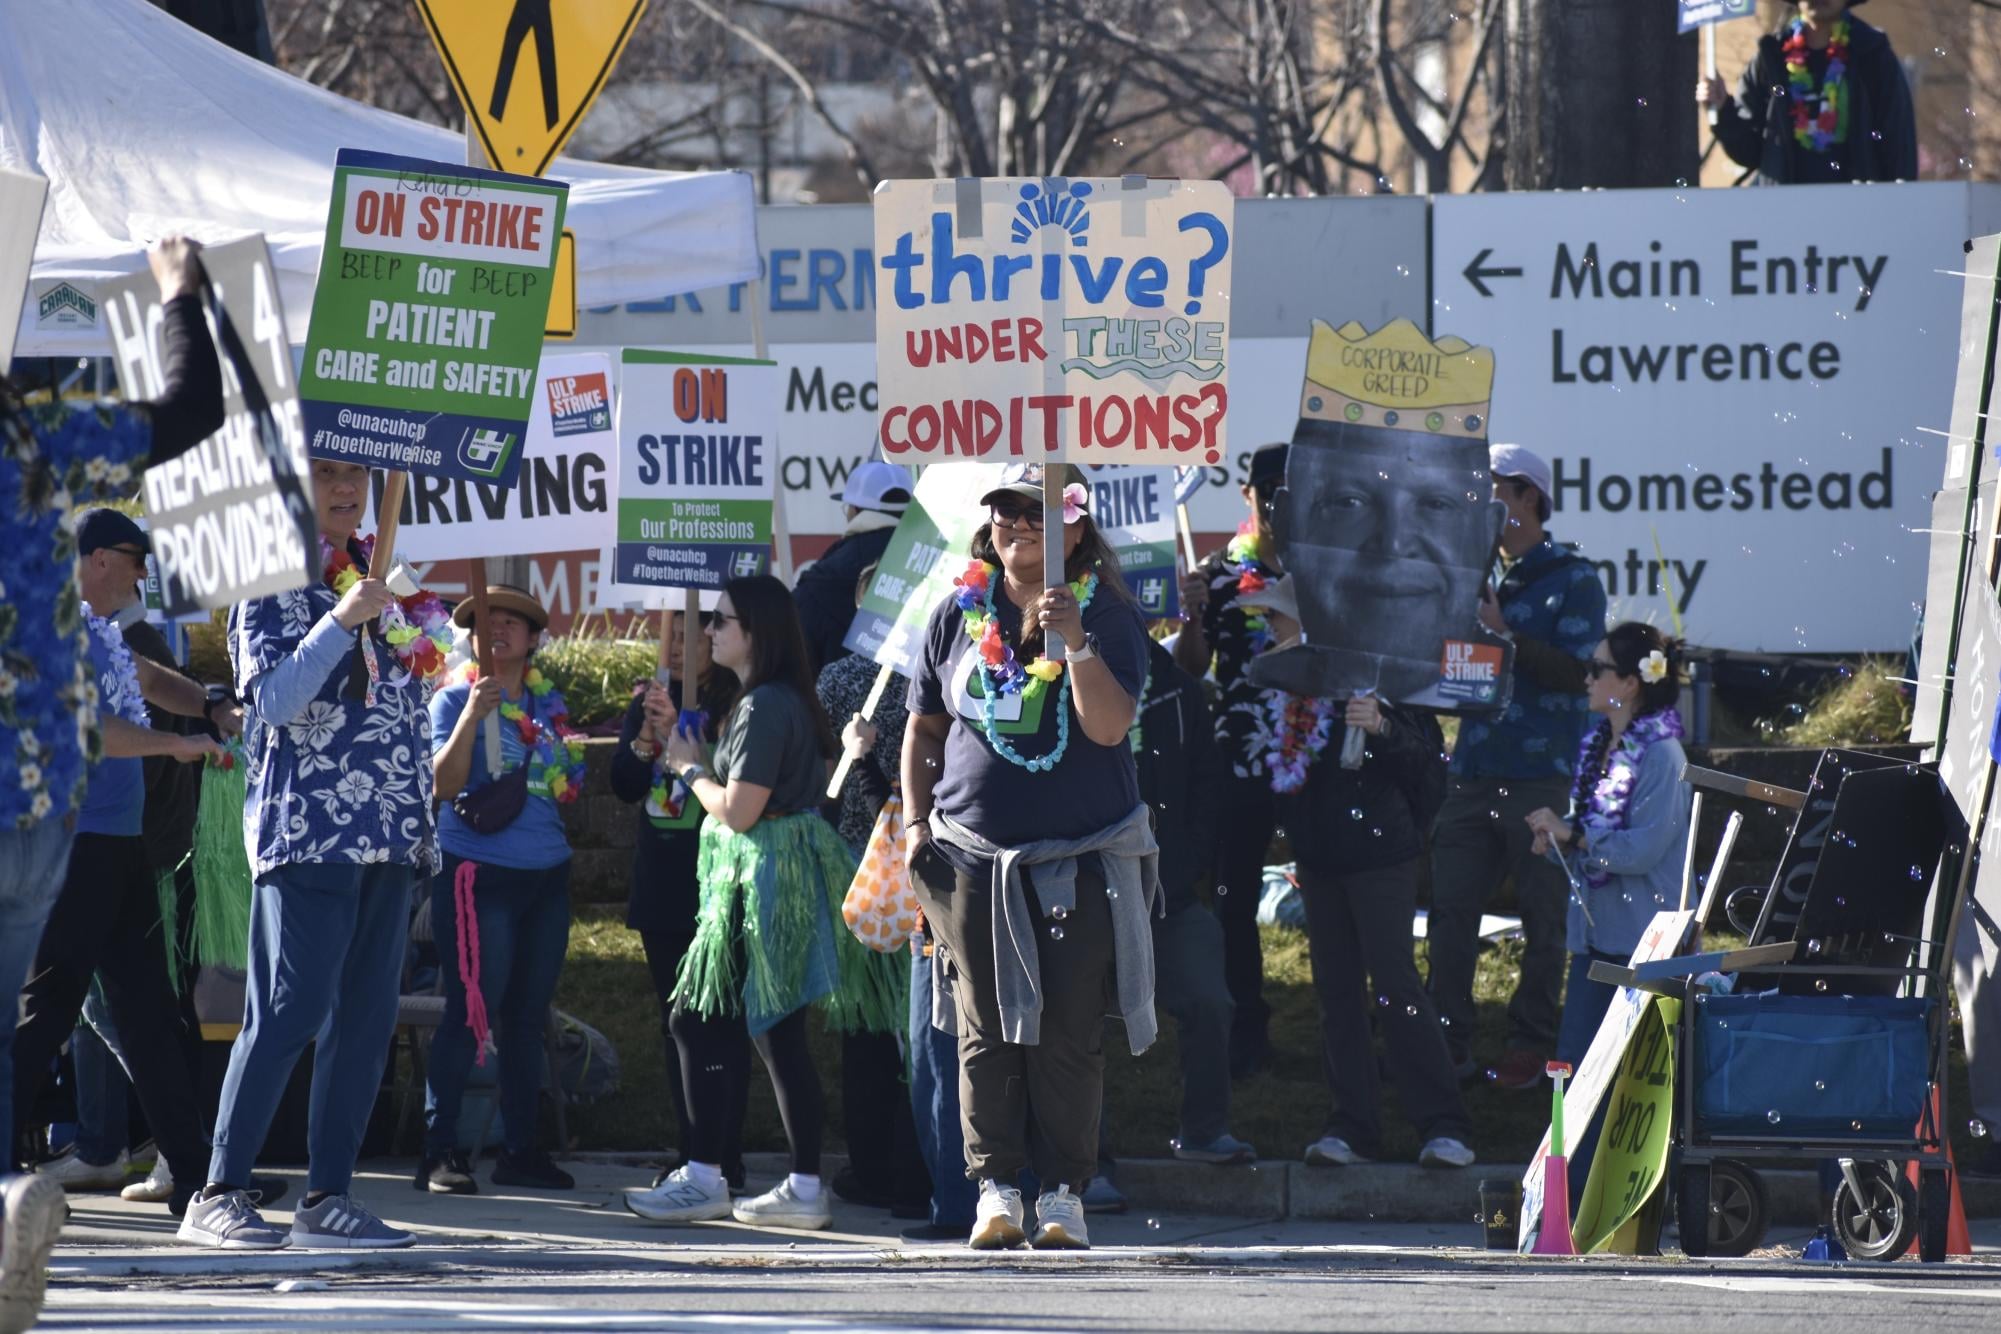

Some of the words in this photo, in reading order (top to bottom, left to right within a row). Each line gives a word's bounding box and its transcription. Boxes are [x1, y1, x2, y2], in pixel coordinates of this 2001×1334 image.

[355, 189, 406, 239] ON
[417, 195, 543, 252] STRIKE
[340, 251, 401, 280] BEEP
[470, 266, 537, 297] BEEP
[416, 262, 456, 295] for
[881, 211, 1229, 316] thrive?
[1550, 241, 1700, 299] Main
[1730, 240, 1889, 312] Entry
[366, 299, 496, 350] PATIENT
[905, 317, 1048, 367] UNDER
[1063, 317, 1225, 362] THESE
[315, 348, 380, 384] CARE
[385, 358, 437, 389] and
[443, 361, 533, 399] SAFETY
[1340, 345, 1448, 379] CORPORATE
[1552, 329, 1841, 384] Lawrence
[549, 378, 576, 399] ULP
[553, 389, 604, 418] STRIKE
[673, 367, 728, 424] ON
[1362, 372, 1429, 398] GREED
[337, 408, 427, 442] @unacuhcp
[880, 382, 1228, 464] CONDITIONS?
[313, 429, 442, 466] #TogetherWeRise
[637, 434, 763, 487] STRIKE
[1552, 447, 1894, 513] Homestead
[640, 518, 667, 539] Our
[670, 518, 755, 539] Professions
[672, 502, 683, 517] To
[685, 502, 721, 517] Protect
[632, 563, 720, 585] #TogetherWeRise
[646, 545, 707, 566] @unacuhcp
[1600, 544, 1708, 614] ntry
[1445, 662, 1495, 681] STRIKE
[1446, 643, 1473, 661] ULP
